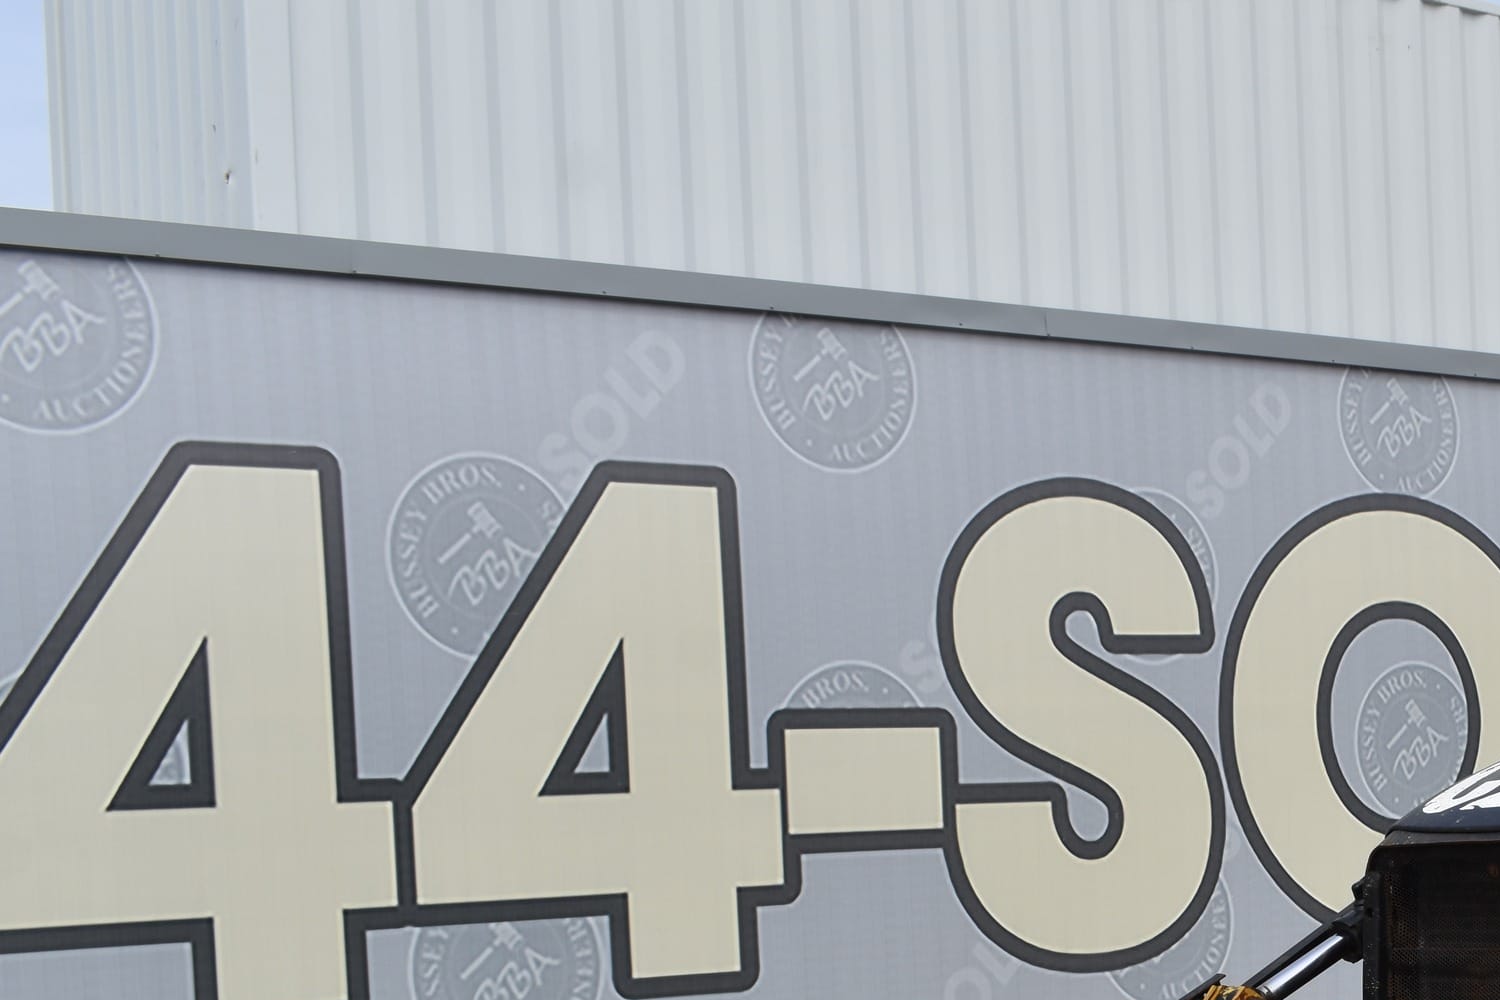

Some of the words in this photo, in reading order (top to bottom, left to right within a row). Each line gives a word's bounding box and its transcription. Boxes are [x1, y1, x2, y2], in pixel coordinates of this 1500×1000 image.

[0, 300, 105, 373] BBA
[800, 360, 880, 421] BBA
[1186, 383, 1291, 519] SOLD
[1376, 405, 1433, 459] BBA
[396, 502, 440, 619] BUSSEY
[420, 462, 503, 505] BROS.
[446, 537, 539, 606] BBA
[1391, 725, 1450, 781] BBA
